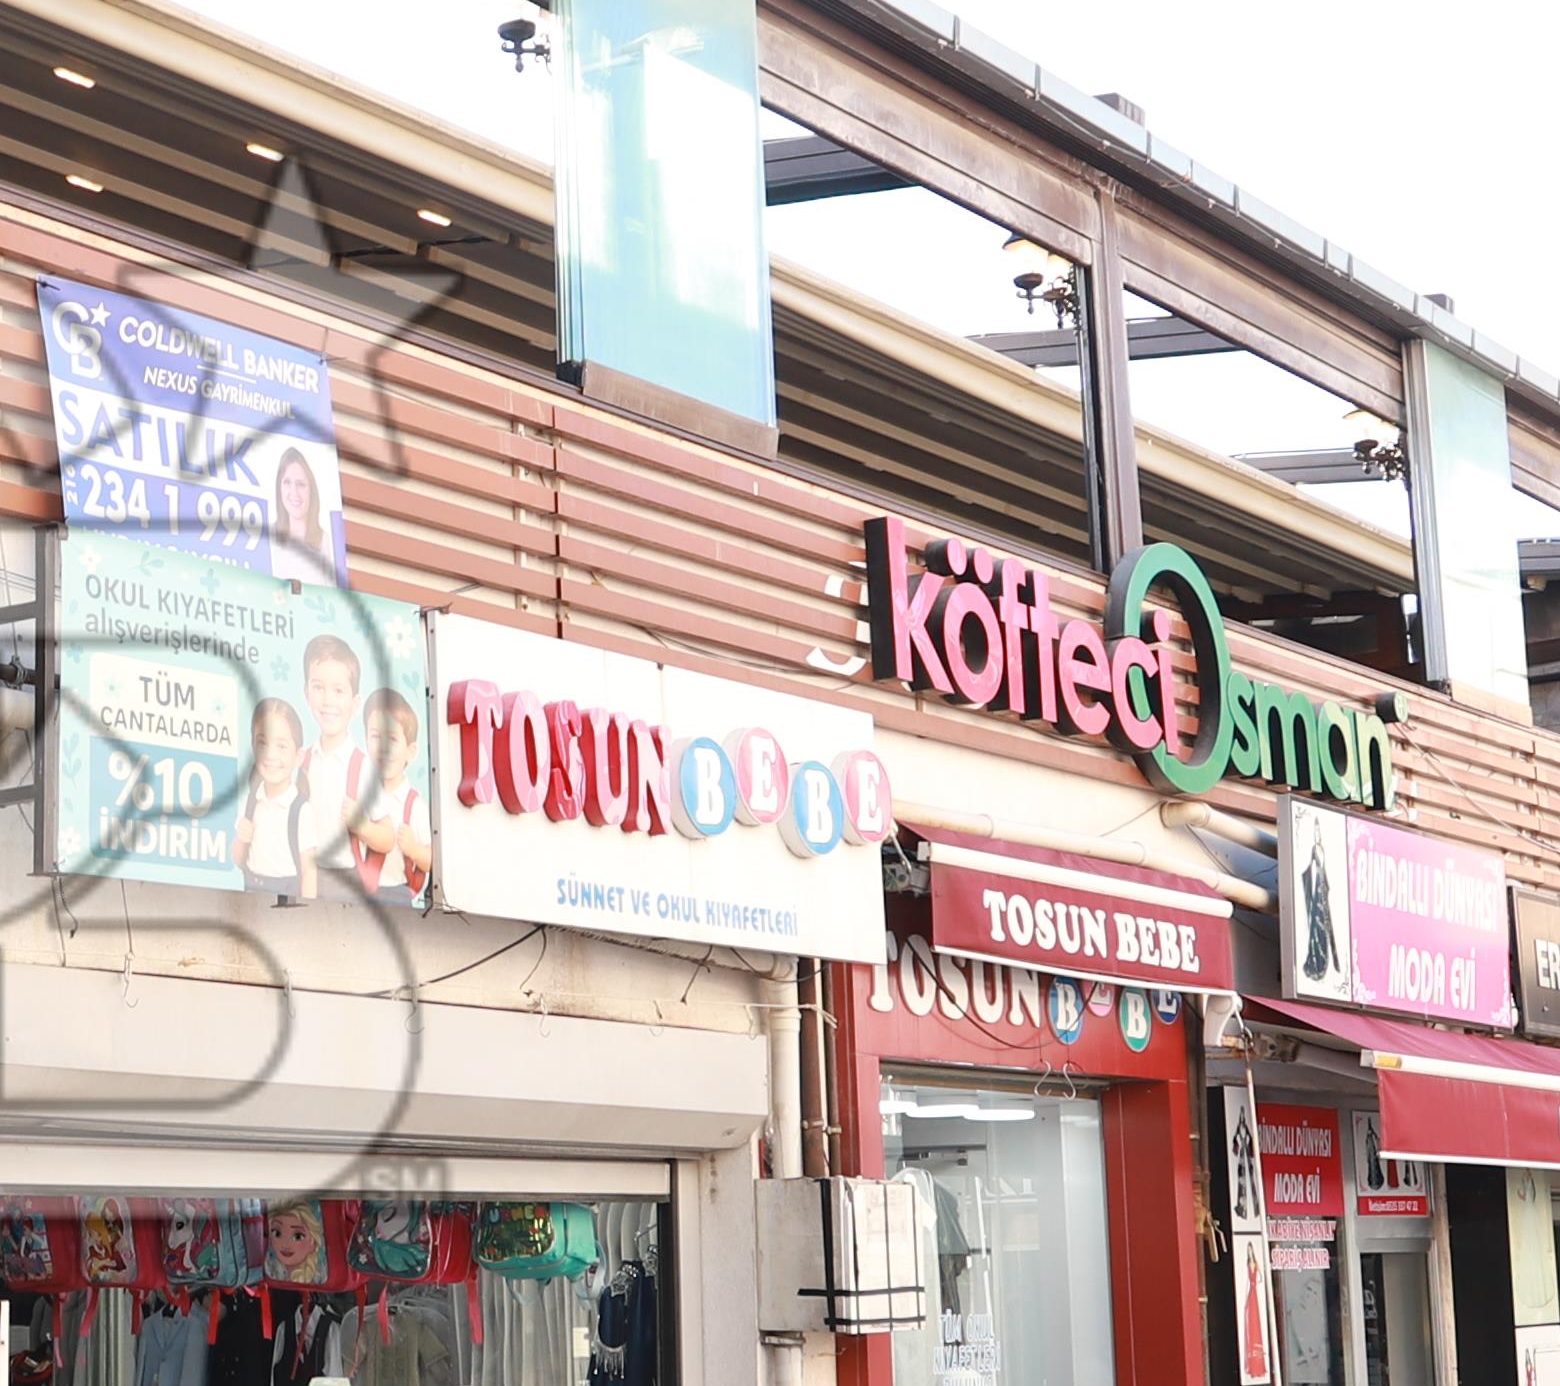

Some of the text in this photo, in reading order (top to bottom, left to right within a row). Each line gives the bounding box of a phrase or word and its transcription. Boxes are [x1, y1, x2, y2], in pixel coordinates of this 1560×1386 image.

[118, 315, 321, 394] COLDWELL BANKER
[143, 366, 296, 420] NEXUS GAYRİMENKUL
[57, 389, 261, 488] SATILIK
[80, 463, 151, 529] 234
[163, 484, 181, 537] 1
[196, 490, 263, 552] 999
[84, 608, 260, 664] alışverişlerinde
[85, 573, 295, 640] OKUL KIYAFETLERİ
[864, 515, 1182, 757] köfteci
[138, 670, 196, 711] TÜM
[99, 706, 233, 747] ÇANTALARDA
[106, 749, 215, 819] %10
[447, 678, 883, 846] TOSUN BEBE
[97, 806, 228, 864] İNDİRİM
[555, 870, 801, 938] SÜNNET VE OKUL KIYAFETLERİ
[1355, 838, 1499, 934] BİNDALLI DÜNYASI
[982, 888, 1201, 974] TOSUN BEBE
[1387, 943, 1477, 1012] MODA EVİ
[1295, 1119, 1332, 1158] DÜNYASI
[1273, 1166, 1321, 1204] MODA EVİ
